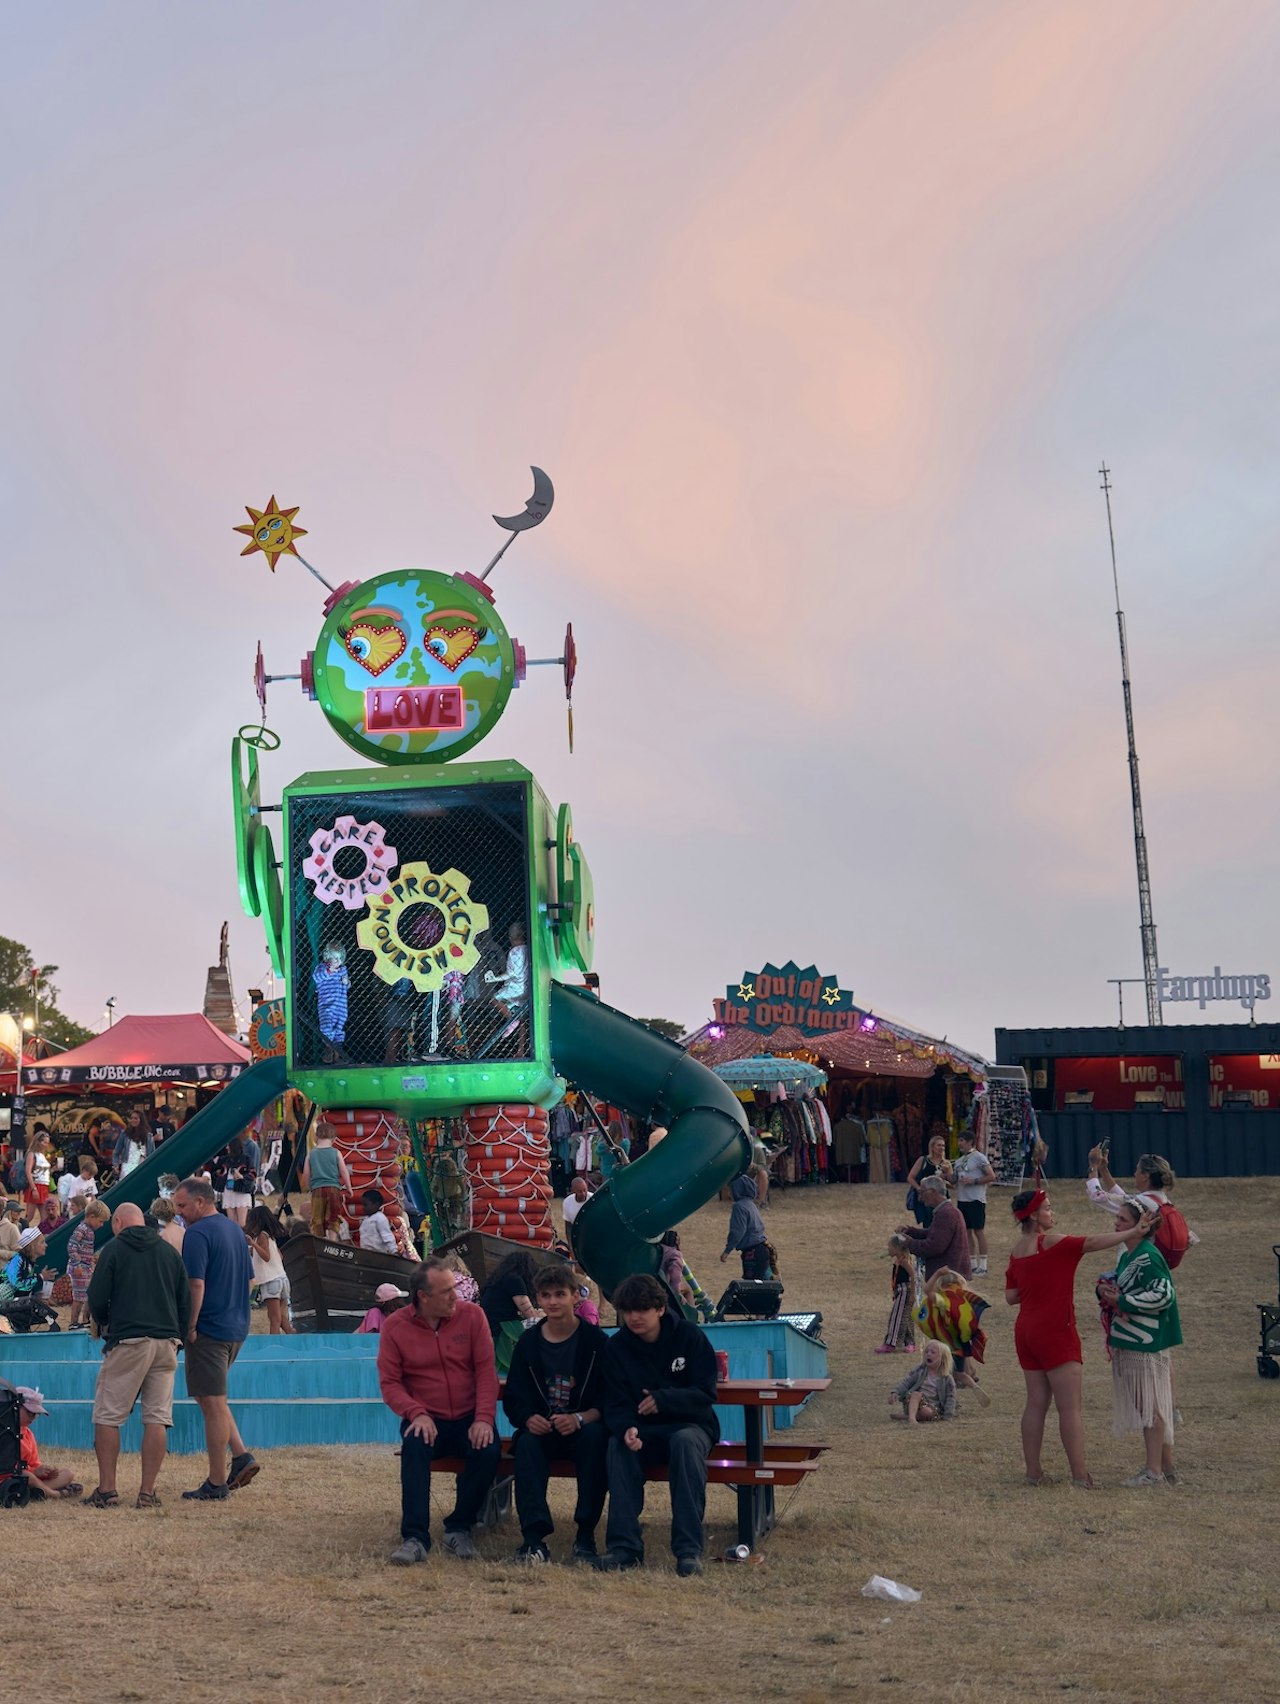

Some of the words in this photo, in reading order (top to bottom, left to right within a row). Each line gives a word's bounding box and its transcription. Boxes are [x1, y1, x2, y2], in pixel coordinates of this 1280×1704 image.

[372, 690, 457, 728] LOVE
[320, 825, 377, 854] CARE
[317, 864, 386, 899] RESPECT
[392, 876, 472, 946] PROTECT
[373, 906, 452, 975] NOURISH
[755, 974, 796, 1000] Out
[799, 976, 824, 1006] of
[1156, 966, 1271, 1010] Earplugs
[712, 997, 750, 1025] The
[755, 1002, 861, 1032] Ordinary
[89, 1065, 142, 1081] BUBBLE
[1120, 1060, 1157, 1083] Love
[1160, 1072, 1173, 1082] The
[324, 1246, 339, 1257] HMS
